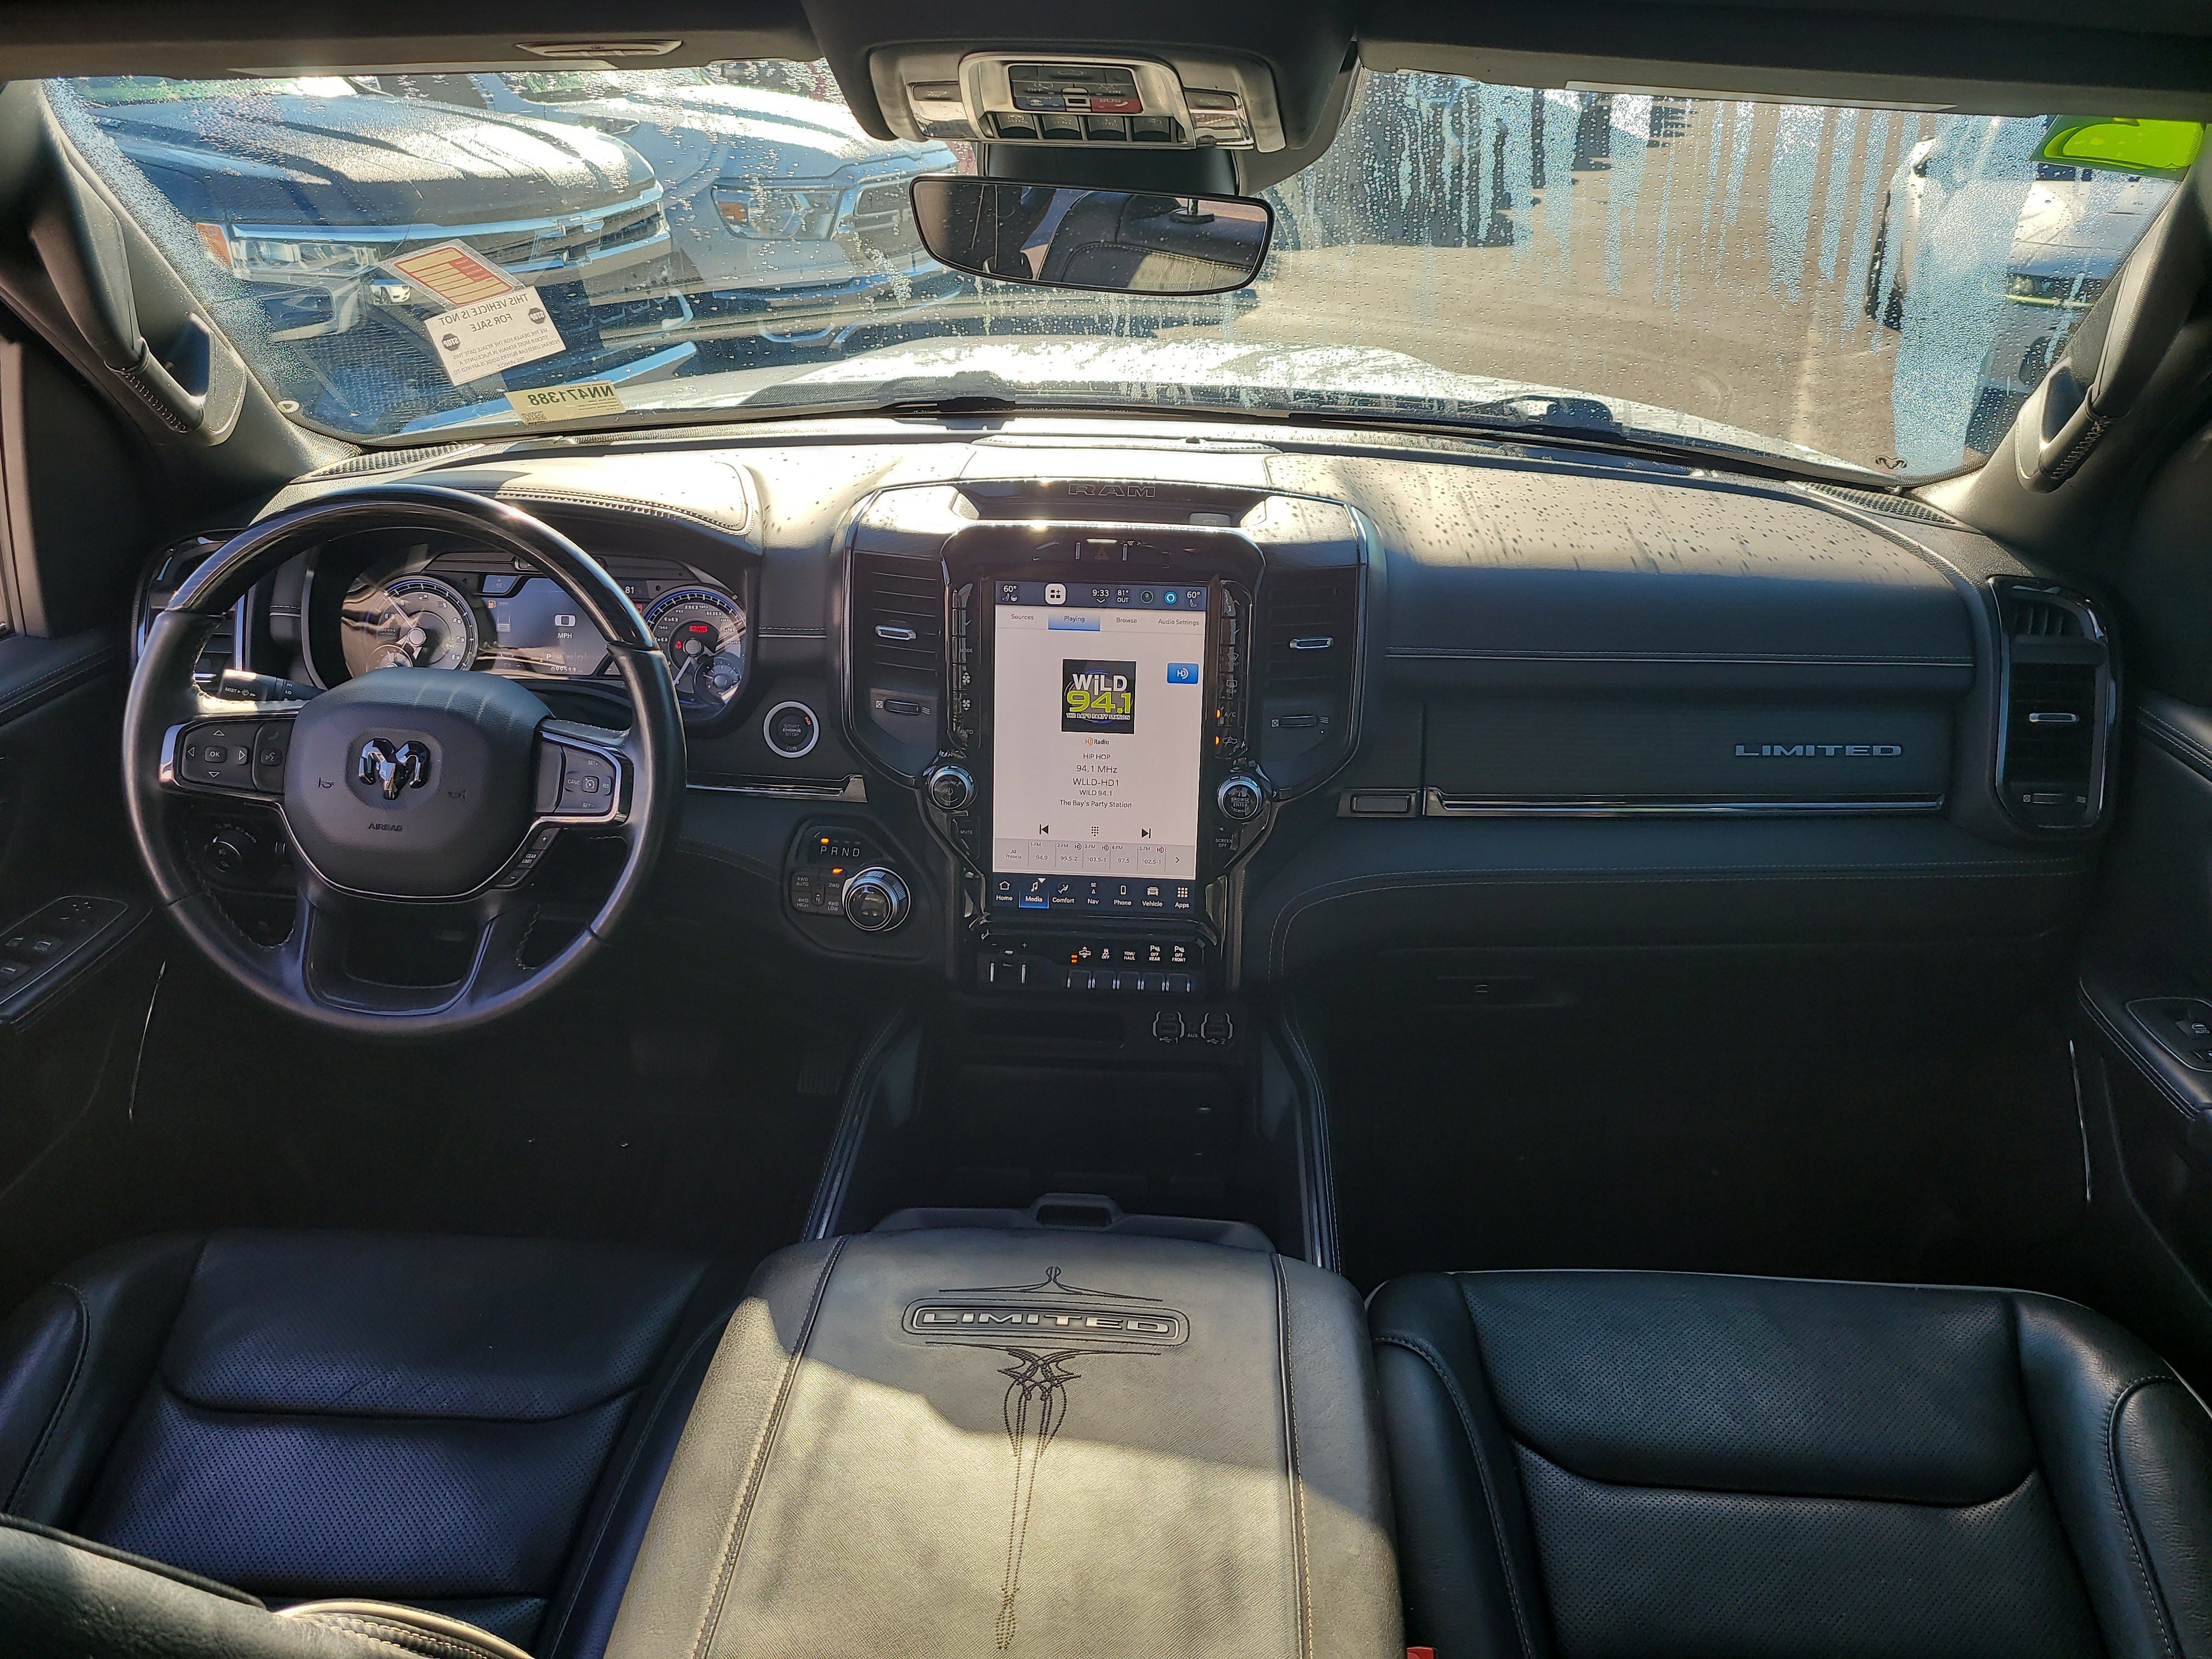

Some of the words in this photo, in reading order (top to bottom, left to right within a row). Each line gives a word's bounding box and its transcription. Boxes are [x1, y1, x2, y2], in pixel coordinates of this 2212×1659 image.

[1069, 484, 1156, 498] RAM
[555, 614, 576, 627] 0
[1067, 690, 1131, 714] 94.1
[1735, 745, 1901, 756] LIMITED
[1073, 778, 1119, 787] WLLD-HD1
[368, 823, 403, 832] AIRBAG
[821, 846, 827, 854] P
[831, 847, 838, 855] R
[842, 847, 849, 856] N
[853, 848, 860, 857] D
[923, 1313, 1169, 1333] LIMITED
